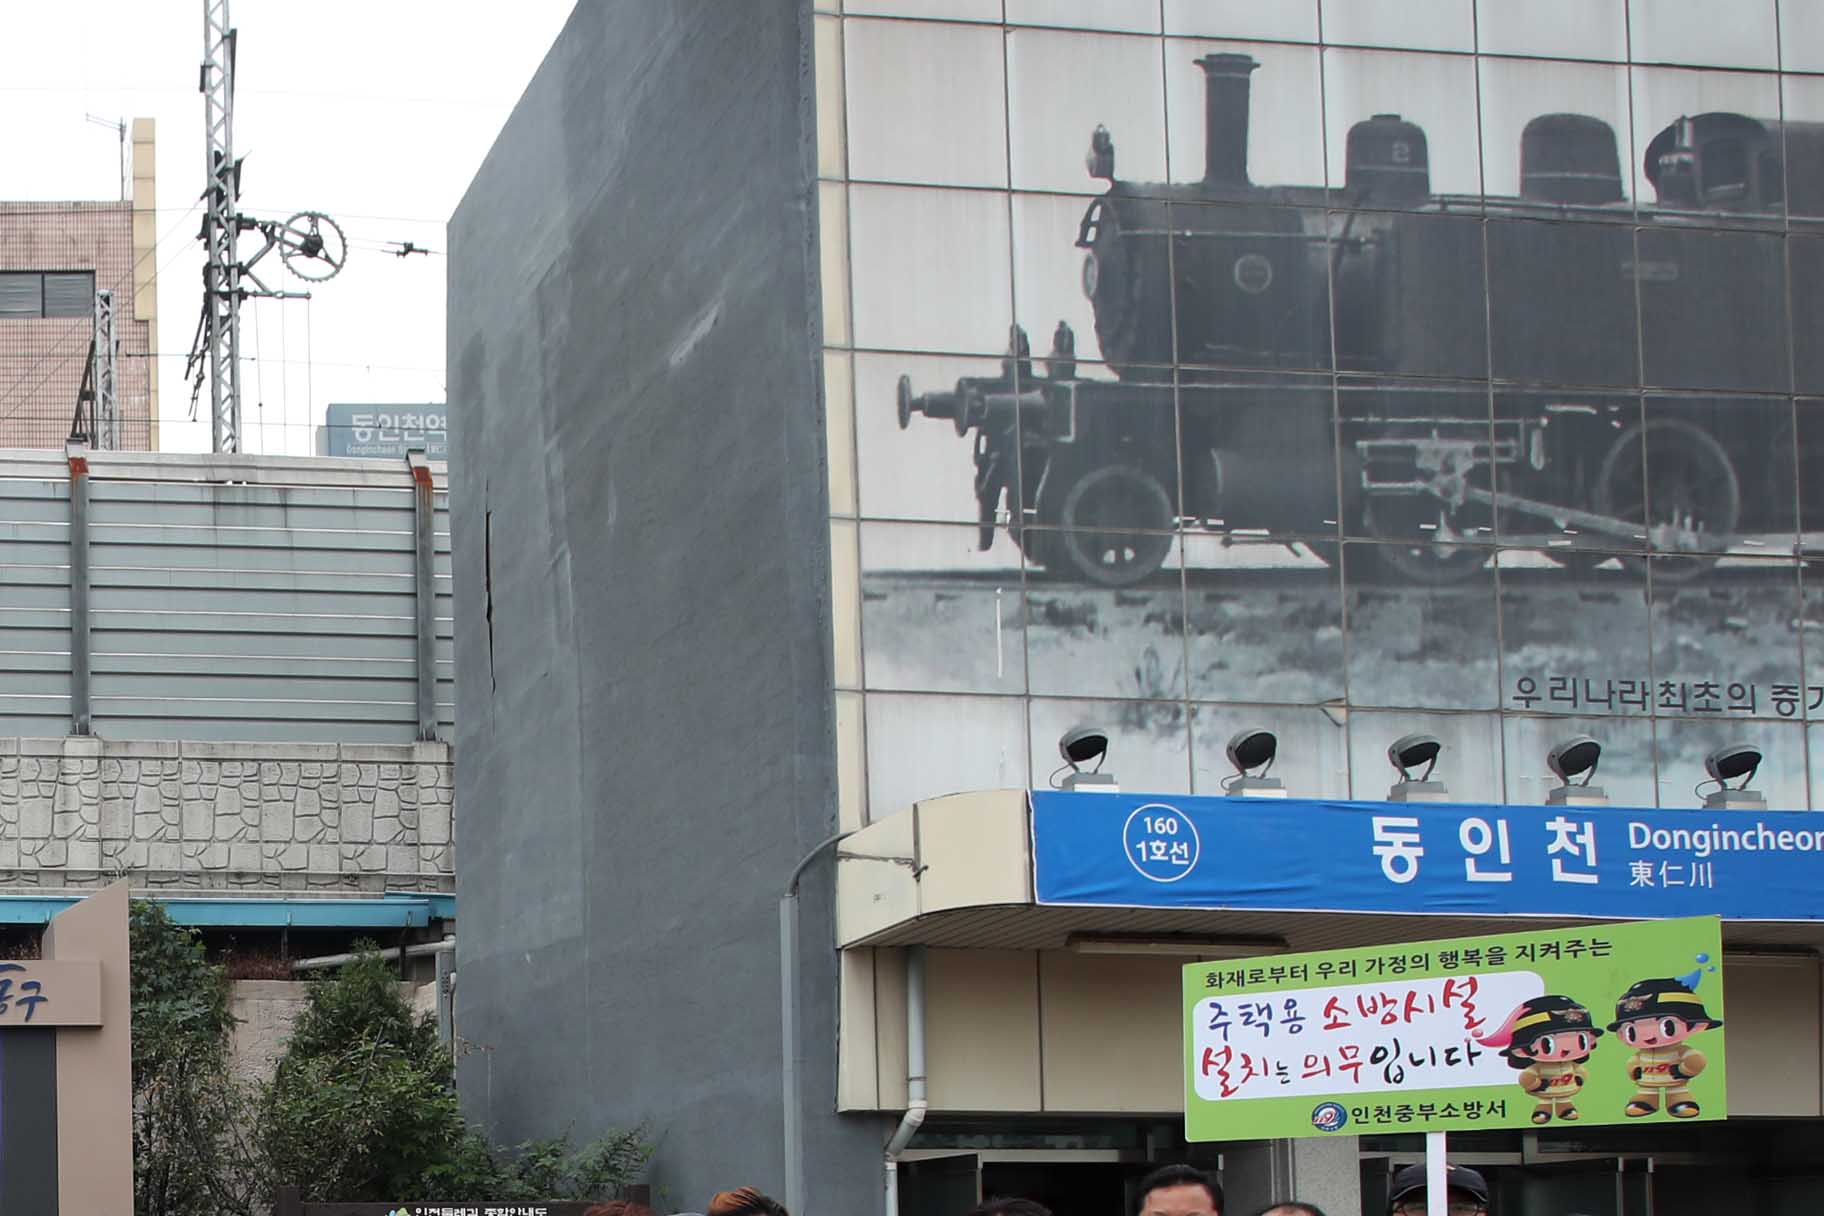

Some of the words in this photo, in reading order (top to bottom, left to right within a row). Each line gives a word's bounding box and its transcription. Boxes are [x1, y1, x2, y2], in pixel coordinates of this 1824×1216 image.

[1143, 817, 1178, 836] 160
[1135, 837, 1191, 867] 1호선
[1629, 860, 1714, 888] 東仁川
[1205, 963, 1310, 990] 화재로부터
[1315, 959, 1358, 981] 우리
[1365, 952, 1431, 978] 가정의
[1438, 946, 1507, 970] 행복을
[1514, 937, 1614, 964] 지켜주는
[1208, 997, 1307, 1034] 주택용
[1322, 976, 1485, 1031] 소방시설
[1202, 1044, 1288, 1098] 설치는
[1301, 1037, 1483, 1086] 의무입니다
[1351, 1100, 1507, 1126] 인천중부소방서
